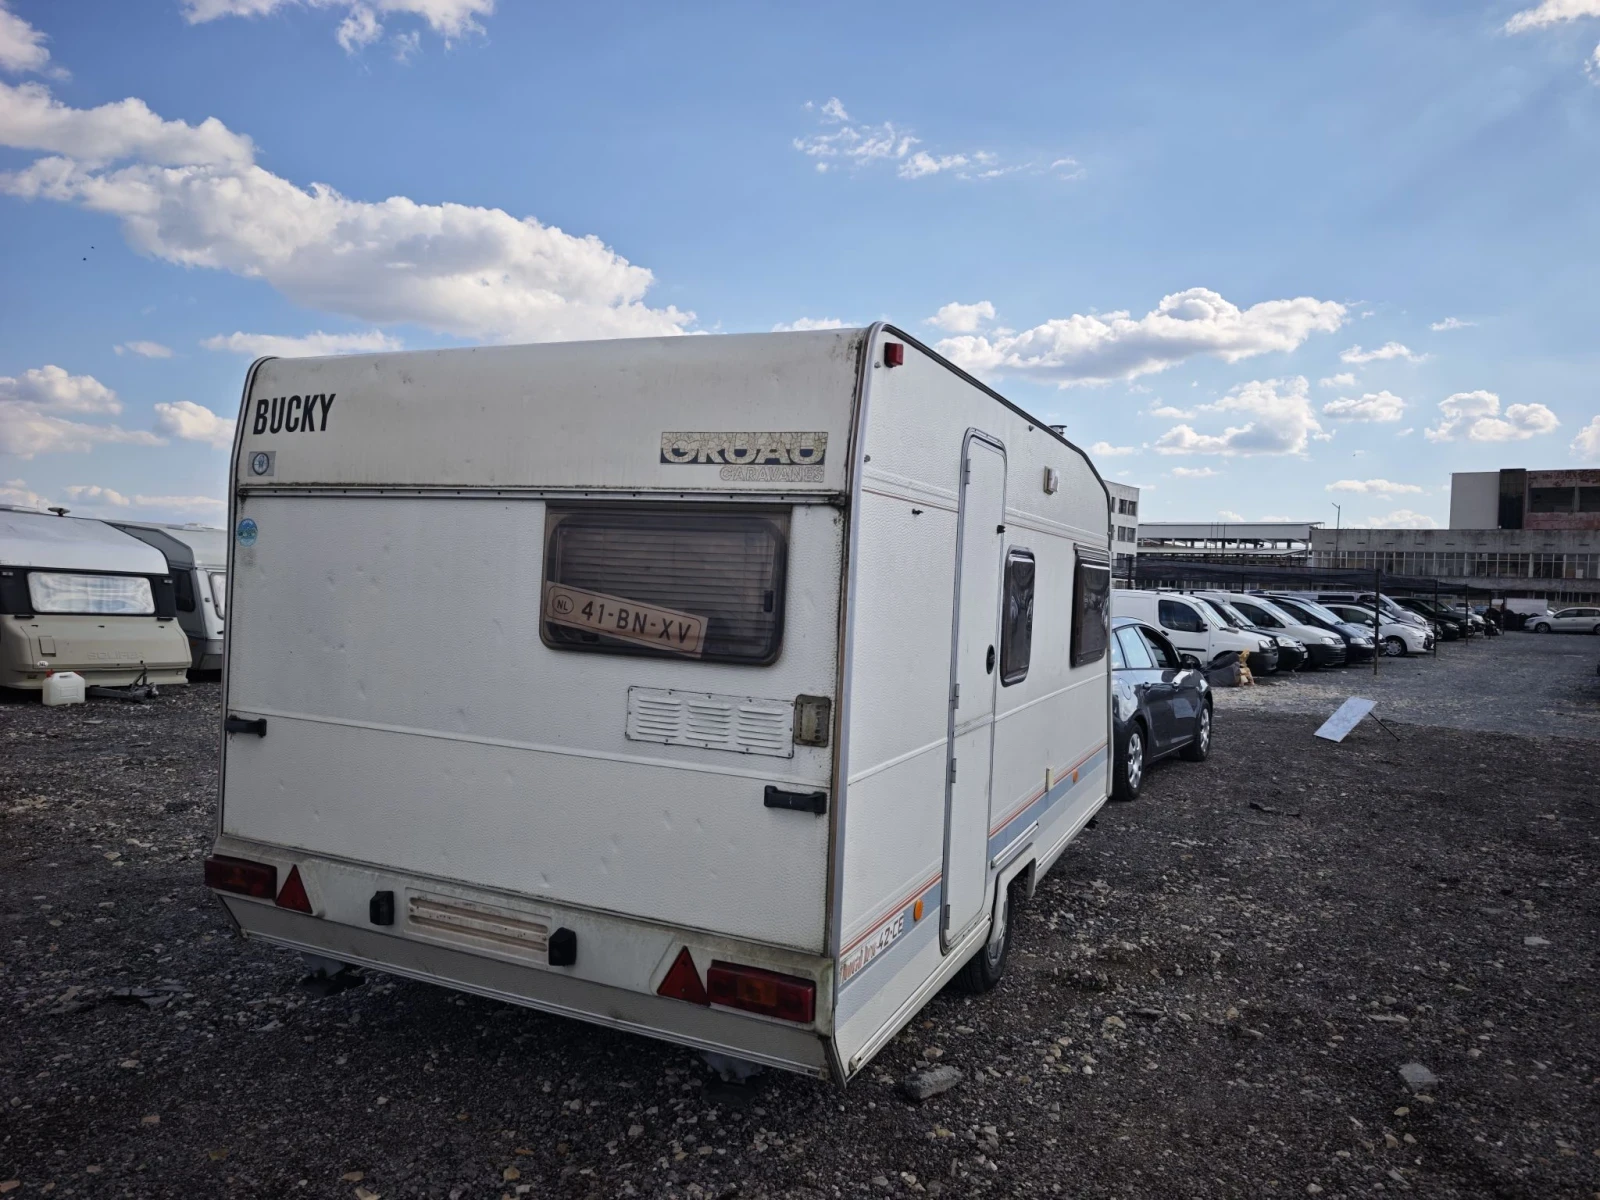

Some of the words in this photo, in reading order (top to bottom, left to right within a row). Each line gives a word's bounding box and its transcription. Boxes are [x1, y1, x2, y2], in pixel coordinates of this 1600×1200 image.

[253, 393, 336, 435] BUCKY
[719, 465, 824, 483] CARAVANES
[556, 599, 569, 612] NL
[581, 600, 691, 643] 41-BN-XV
